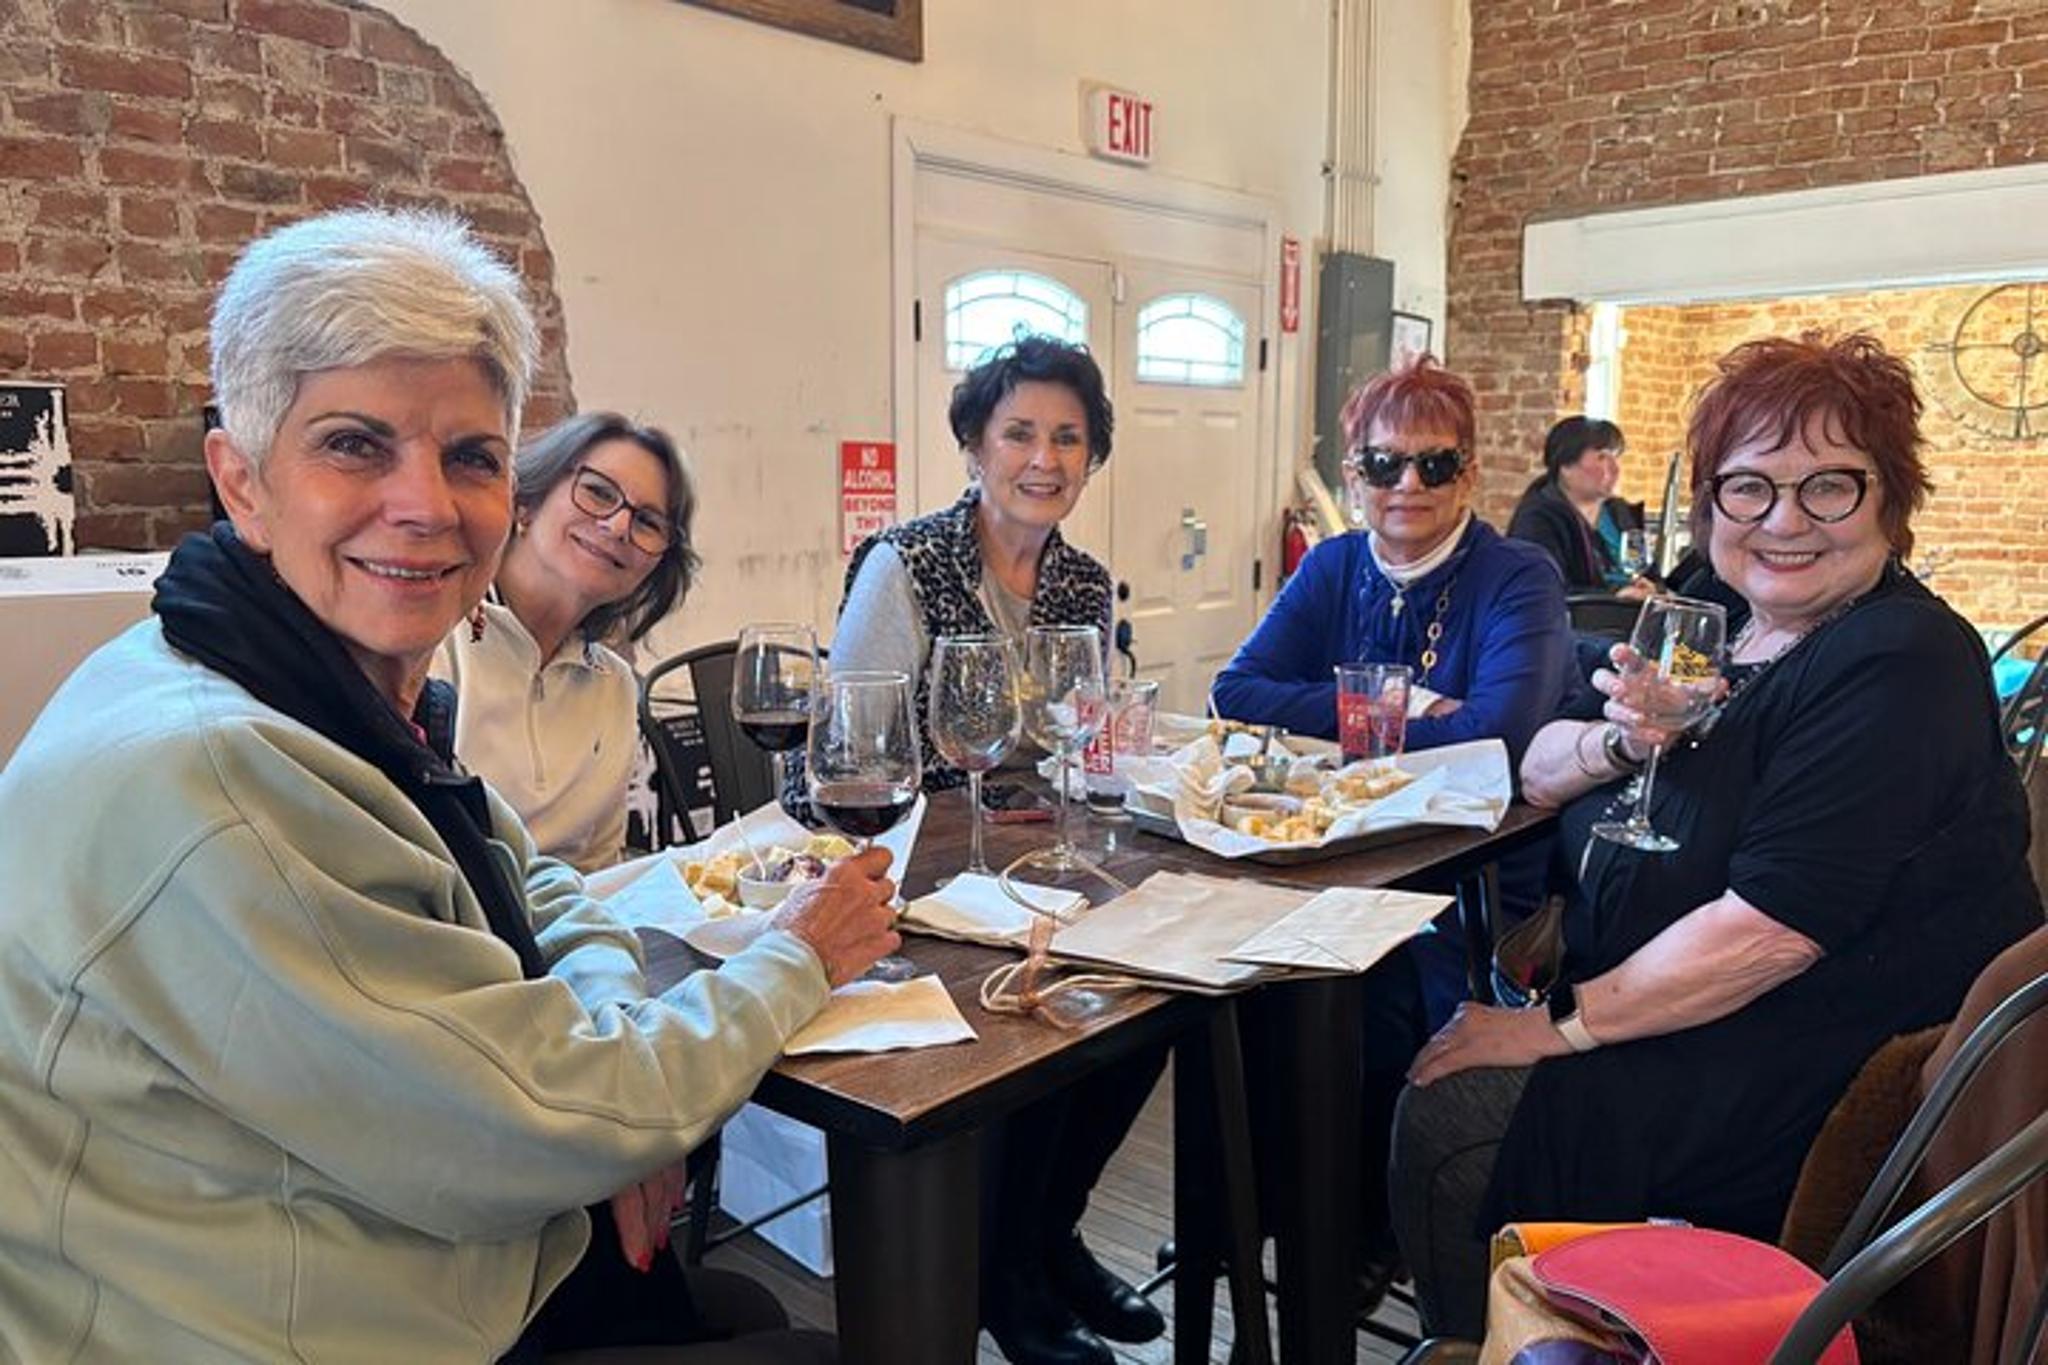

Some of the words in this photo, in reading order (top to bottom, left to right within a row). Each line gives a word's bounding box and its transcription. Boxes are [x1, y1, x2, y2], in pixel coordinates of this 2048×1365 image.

[1109, 94, 1152, 158] EXIT
[861, 446, 879, 468] NO
[844, 498, 896, 512] BEYOND
